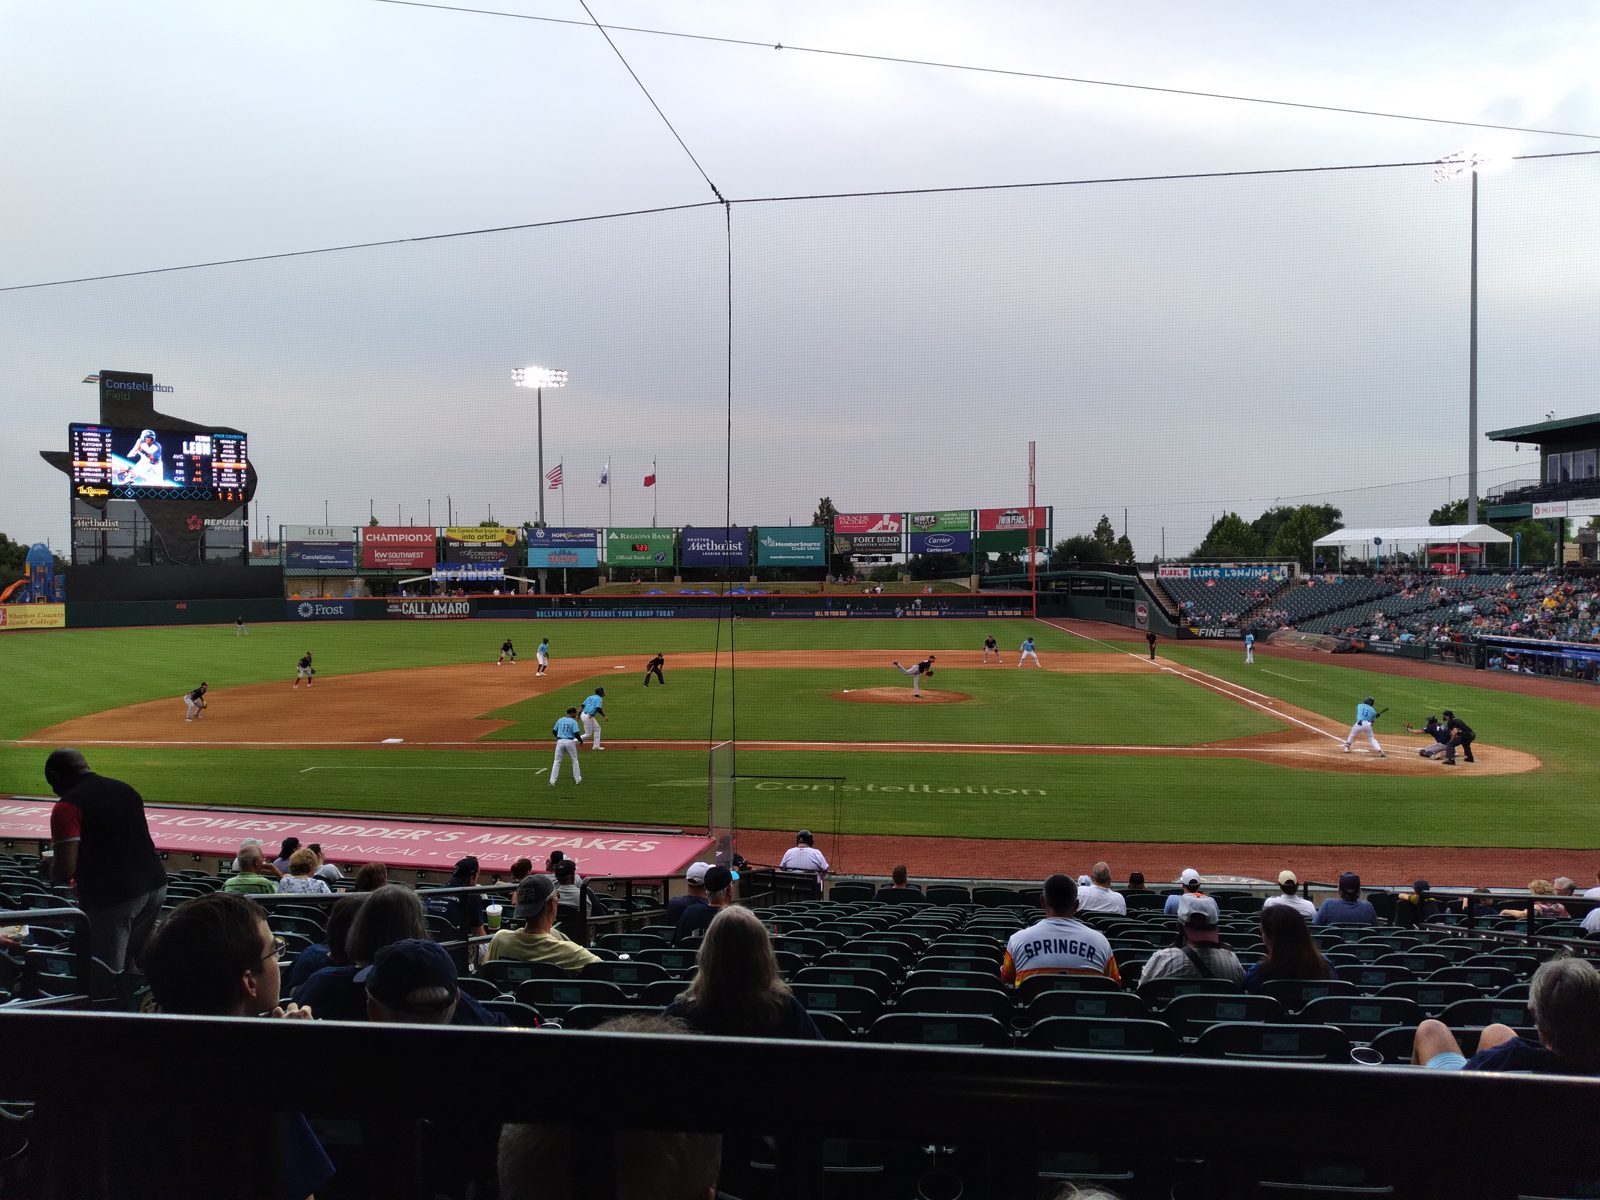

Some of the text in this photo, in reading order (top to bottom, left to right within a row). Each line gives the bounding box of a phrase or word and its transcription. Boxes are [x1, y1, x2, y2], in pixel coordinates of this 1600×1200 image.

[106, 379, 174, 392] Constellation
[106, 390, 130, 400] Field
[688, 540, 743, 550] Methodist
[375, 550, 387, 558] kw
[315, 604, 344, 615] Frost
[402, 603, 427, 614] CALL
[430, 603, 470, 614] AMARO
[1199, 629, 1225, 637] FINE
[754, 781, 1048, 796] Constellation
[150, 832, 244, 845] OFTWARE
[158, 816, 661, 852] LOWEST BIDDER'S MISTAKES
[1023, 938, 1097, 960] SPRINGER
